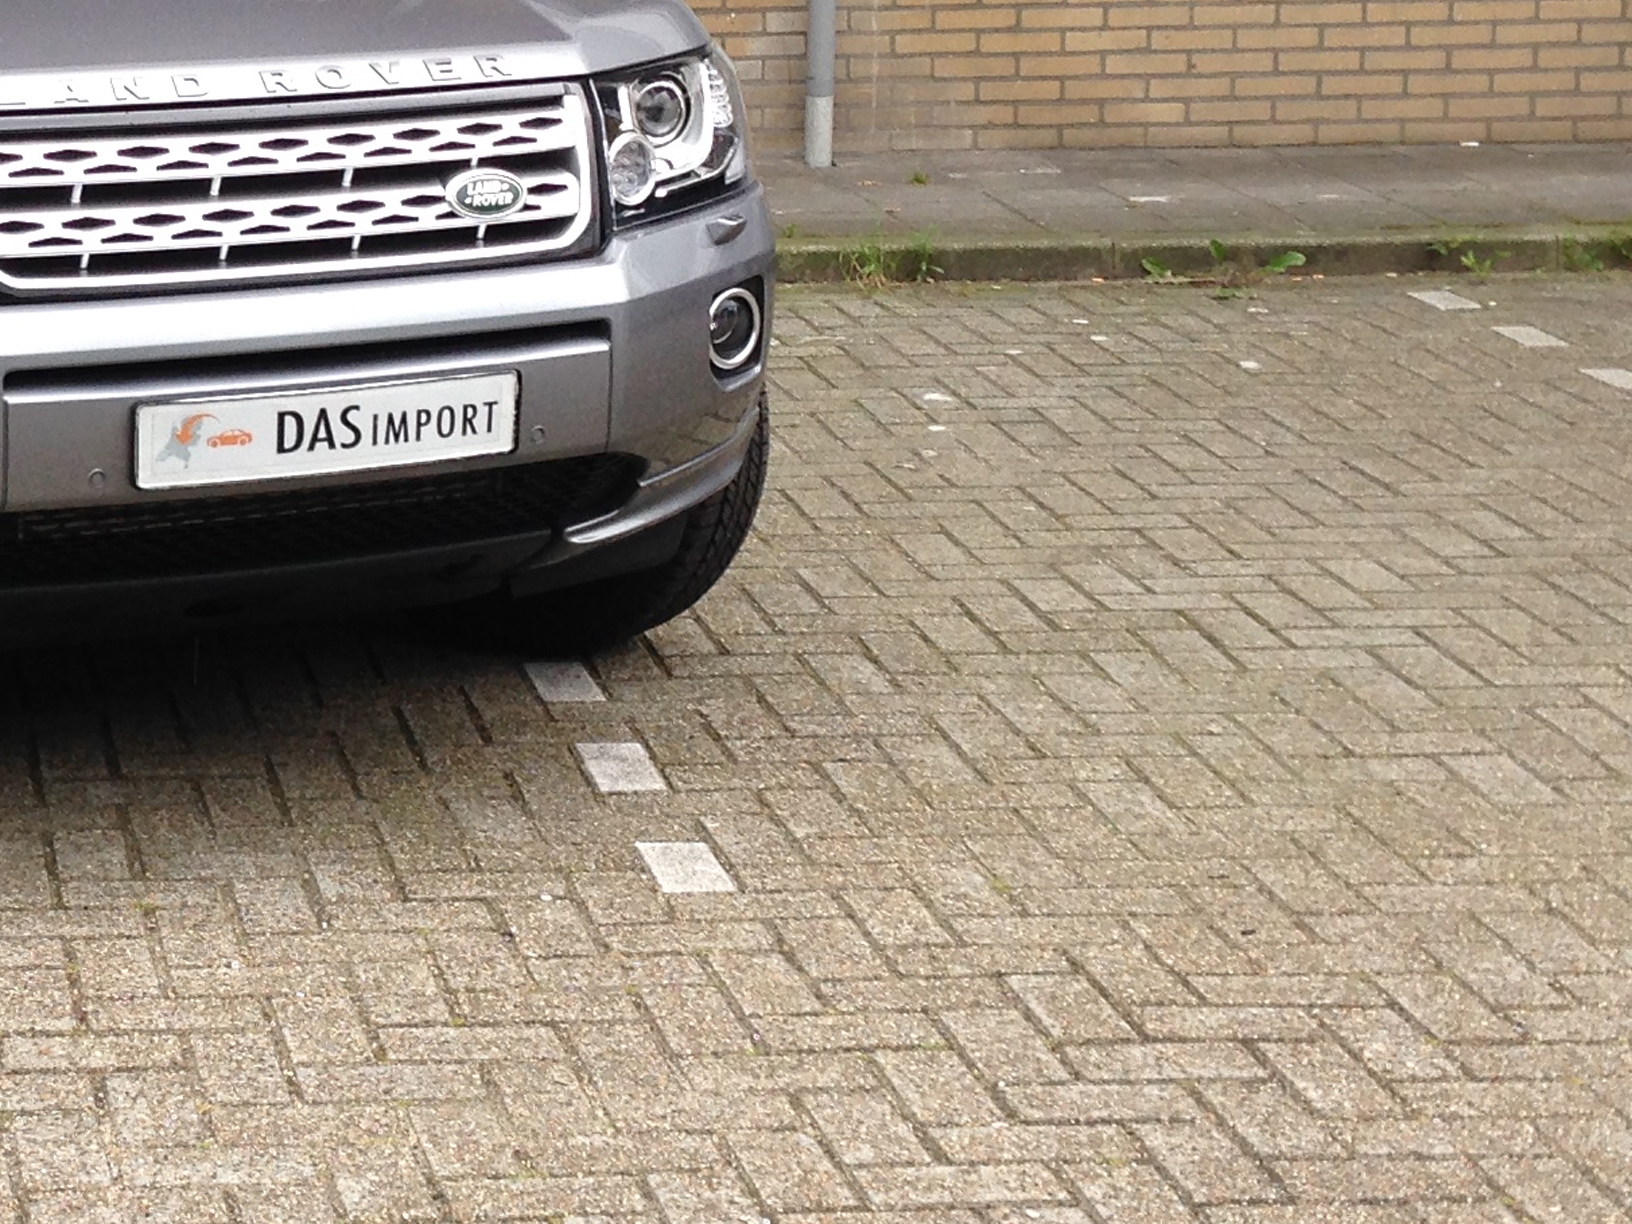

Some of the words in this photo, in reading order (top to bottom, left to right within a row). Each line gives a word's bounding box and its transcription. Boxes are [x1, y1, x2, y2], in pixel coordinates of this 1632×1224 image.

[258, 54, 513, 94] ROVER
[466, 178, 502, 196] LAND
[472, 191, 515, 207] ROVER
[275, 404, 363, 455] DAS
[371, 400, 500, 448] IMPORT
